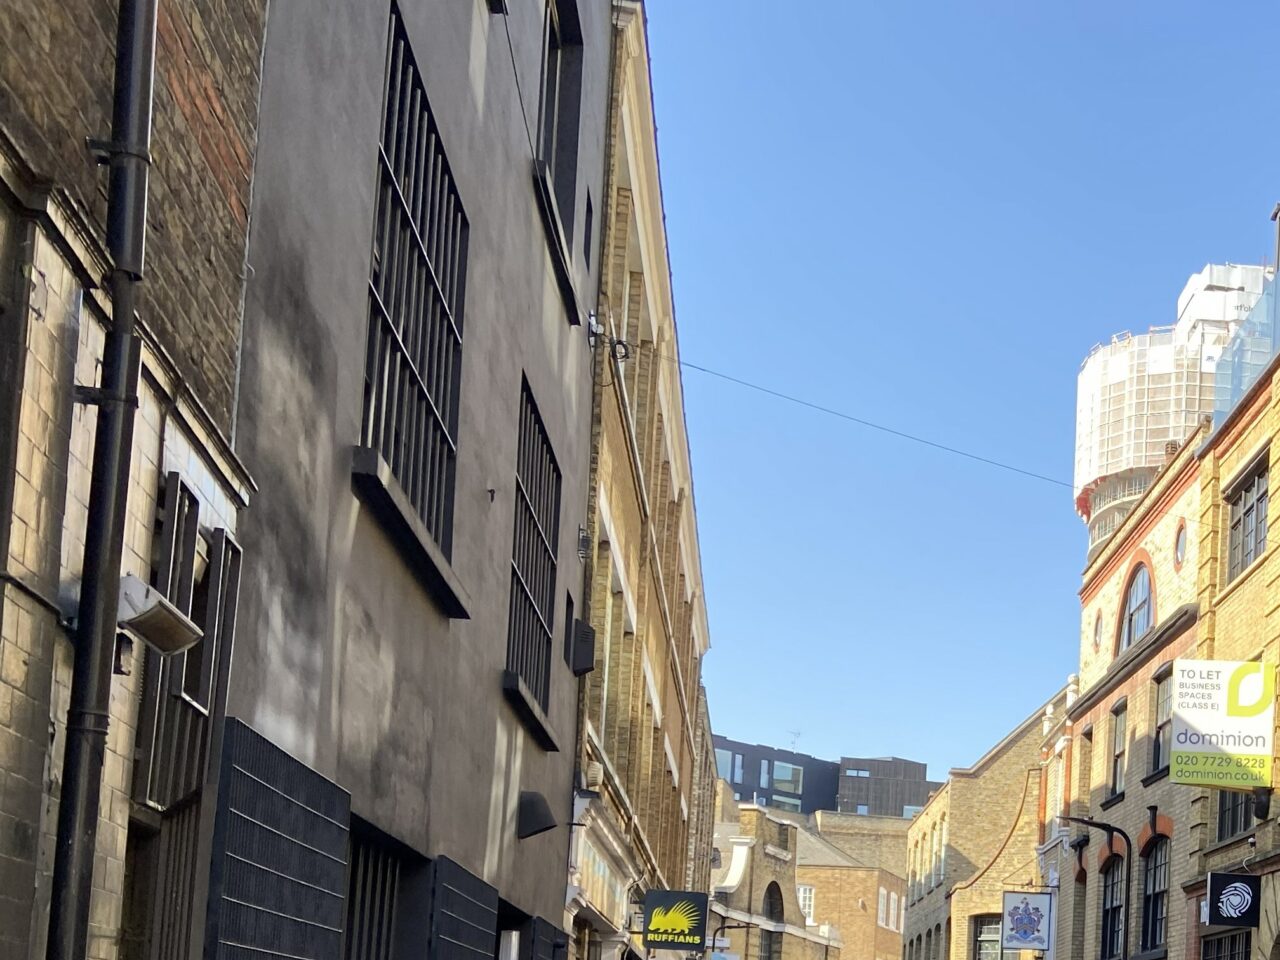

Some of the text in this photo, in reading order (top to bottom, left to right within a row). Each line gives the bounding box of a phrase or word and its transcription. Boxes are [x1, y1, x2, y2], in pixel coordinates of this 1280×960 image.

[1180, 669, 1222, 680] TO LET
[1179, 682, 1221, 691] BUSINESS
[1178, 692, 1212, 700] SPACES
[1178, 701, 1219, 711] (CLASS E)
[1176, 728, 1266, 748] dominion
[1175, 755, 1265, 769] 020 7729 8228
[1175, 768, 1265, 782] dominion.co.uk
[647, 933, 701, 944] RUFFIANS
